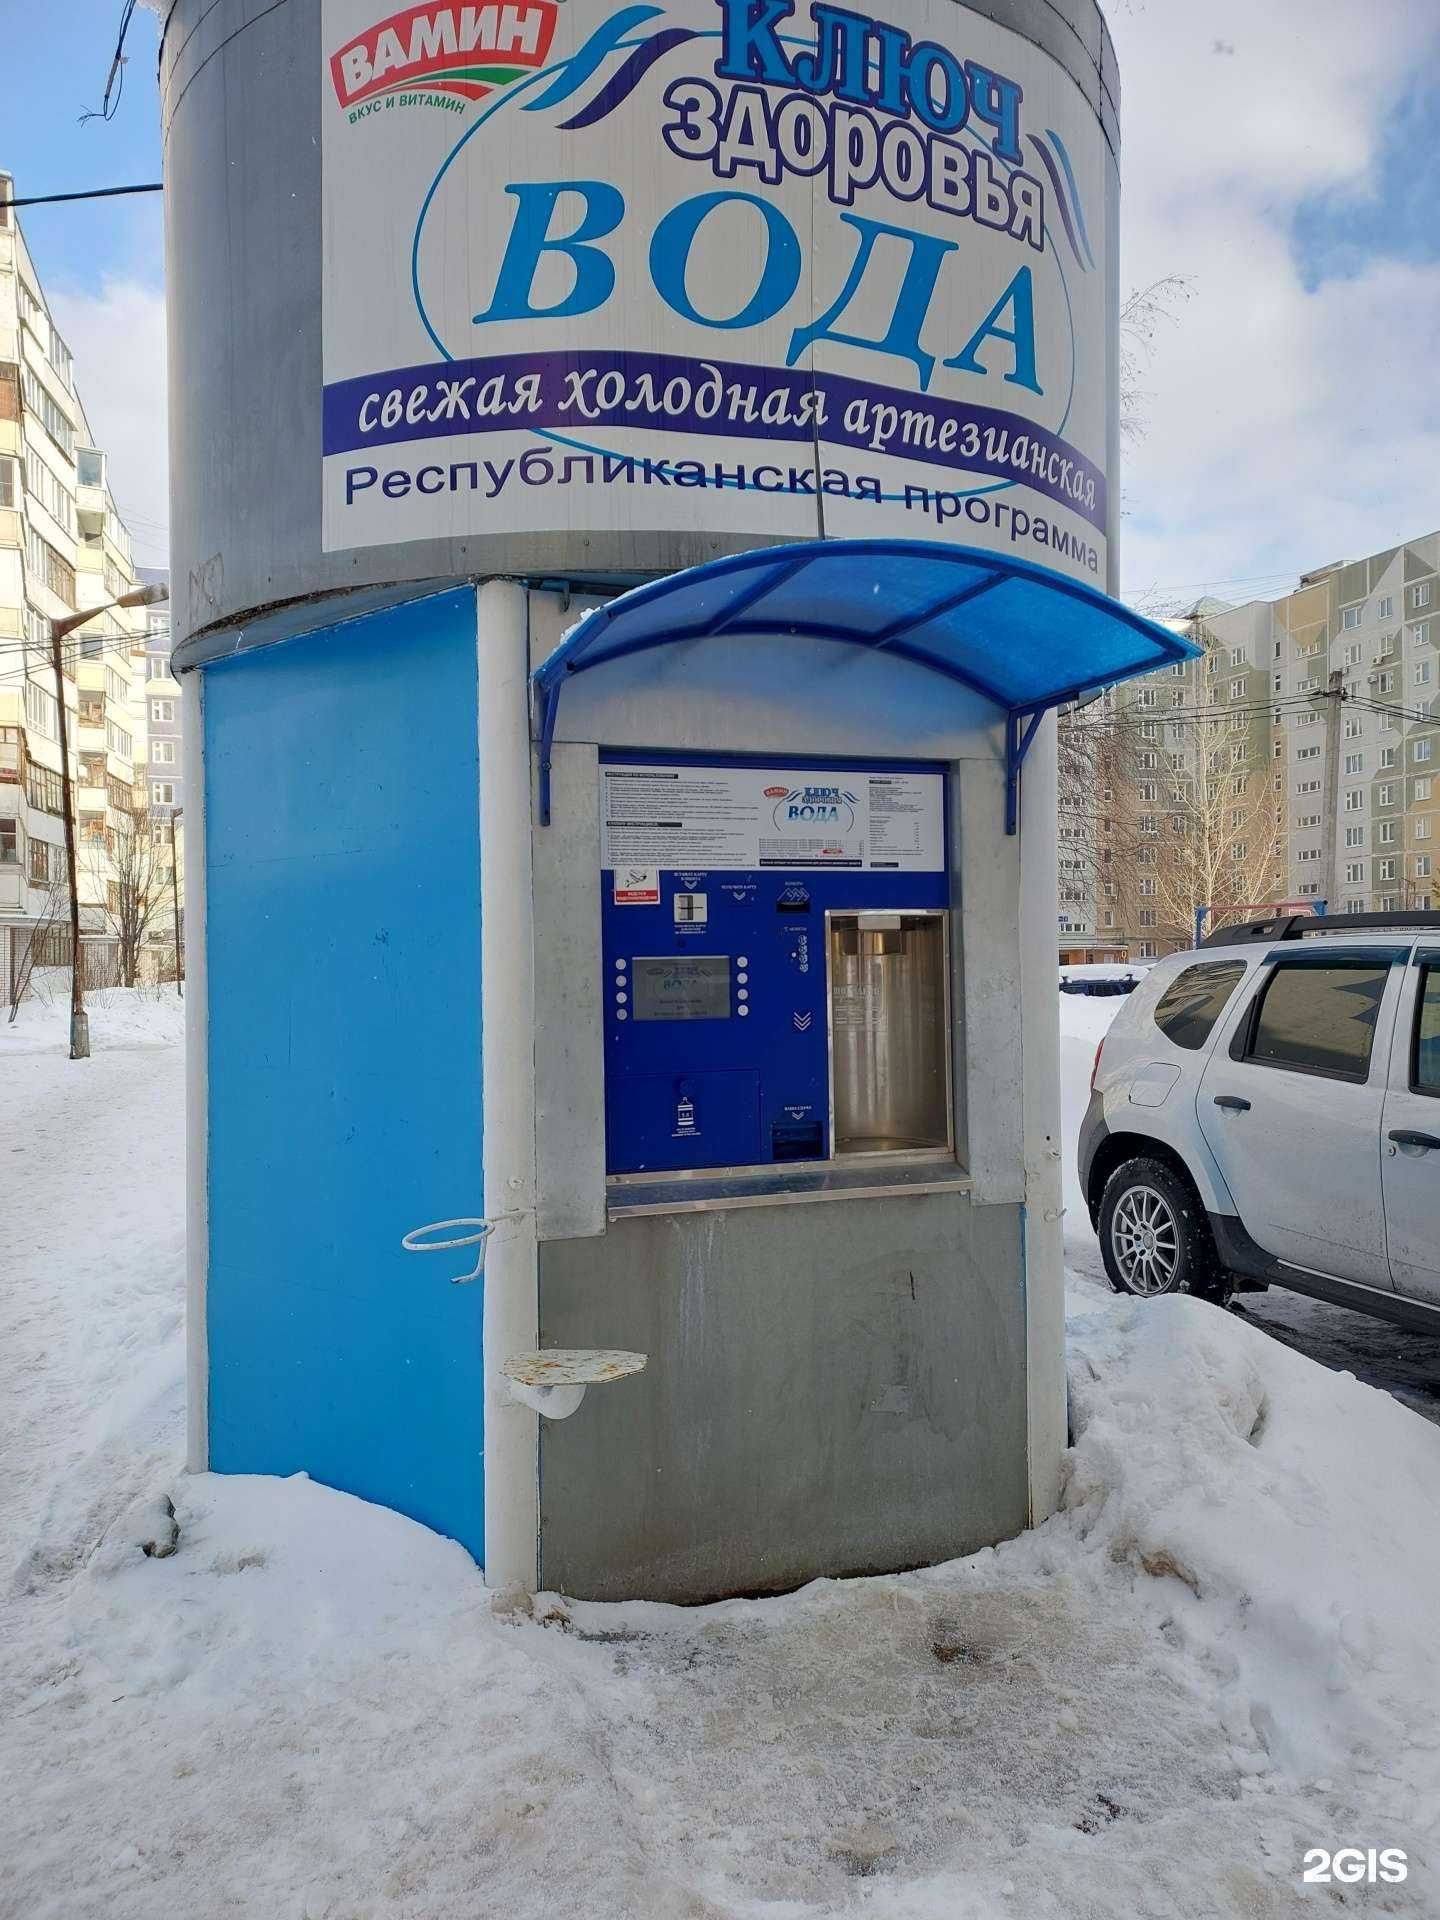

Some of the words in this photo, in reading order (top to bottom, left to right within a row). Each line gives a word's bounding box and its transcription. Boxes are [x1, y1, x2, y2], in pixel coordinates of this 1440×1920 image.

[340, 3, 544, 98] ВАМИН
[348, 100, 382, 125] ВКУС
[385, 98, 396, 109] И
[399, 94, 466, 115] ВИТАМИН
[472, 180, 1044, 397] ВОДА
[358, 372, 545, 433] свежая
[557, 362, 829, 428] холодная
[844, 397, 1097, 512] артезианская
[345, 446, 882, 505] Республиканская
[904, 483, 1099, 575] программа
[785, 806, 840, 824] ВОДА
